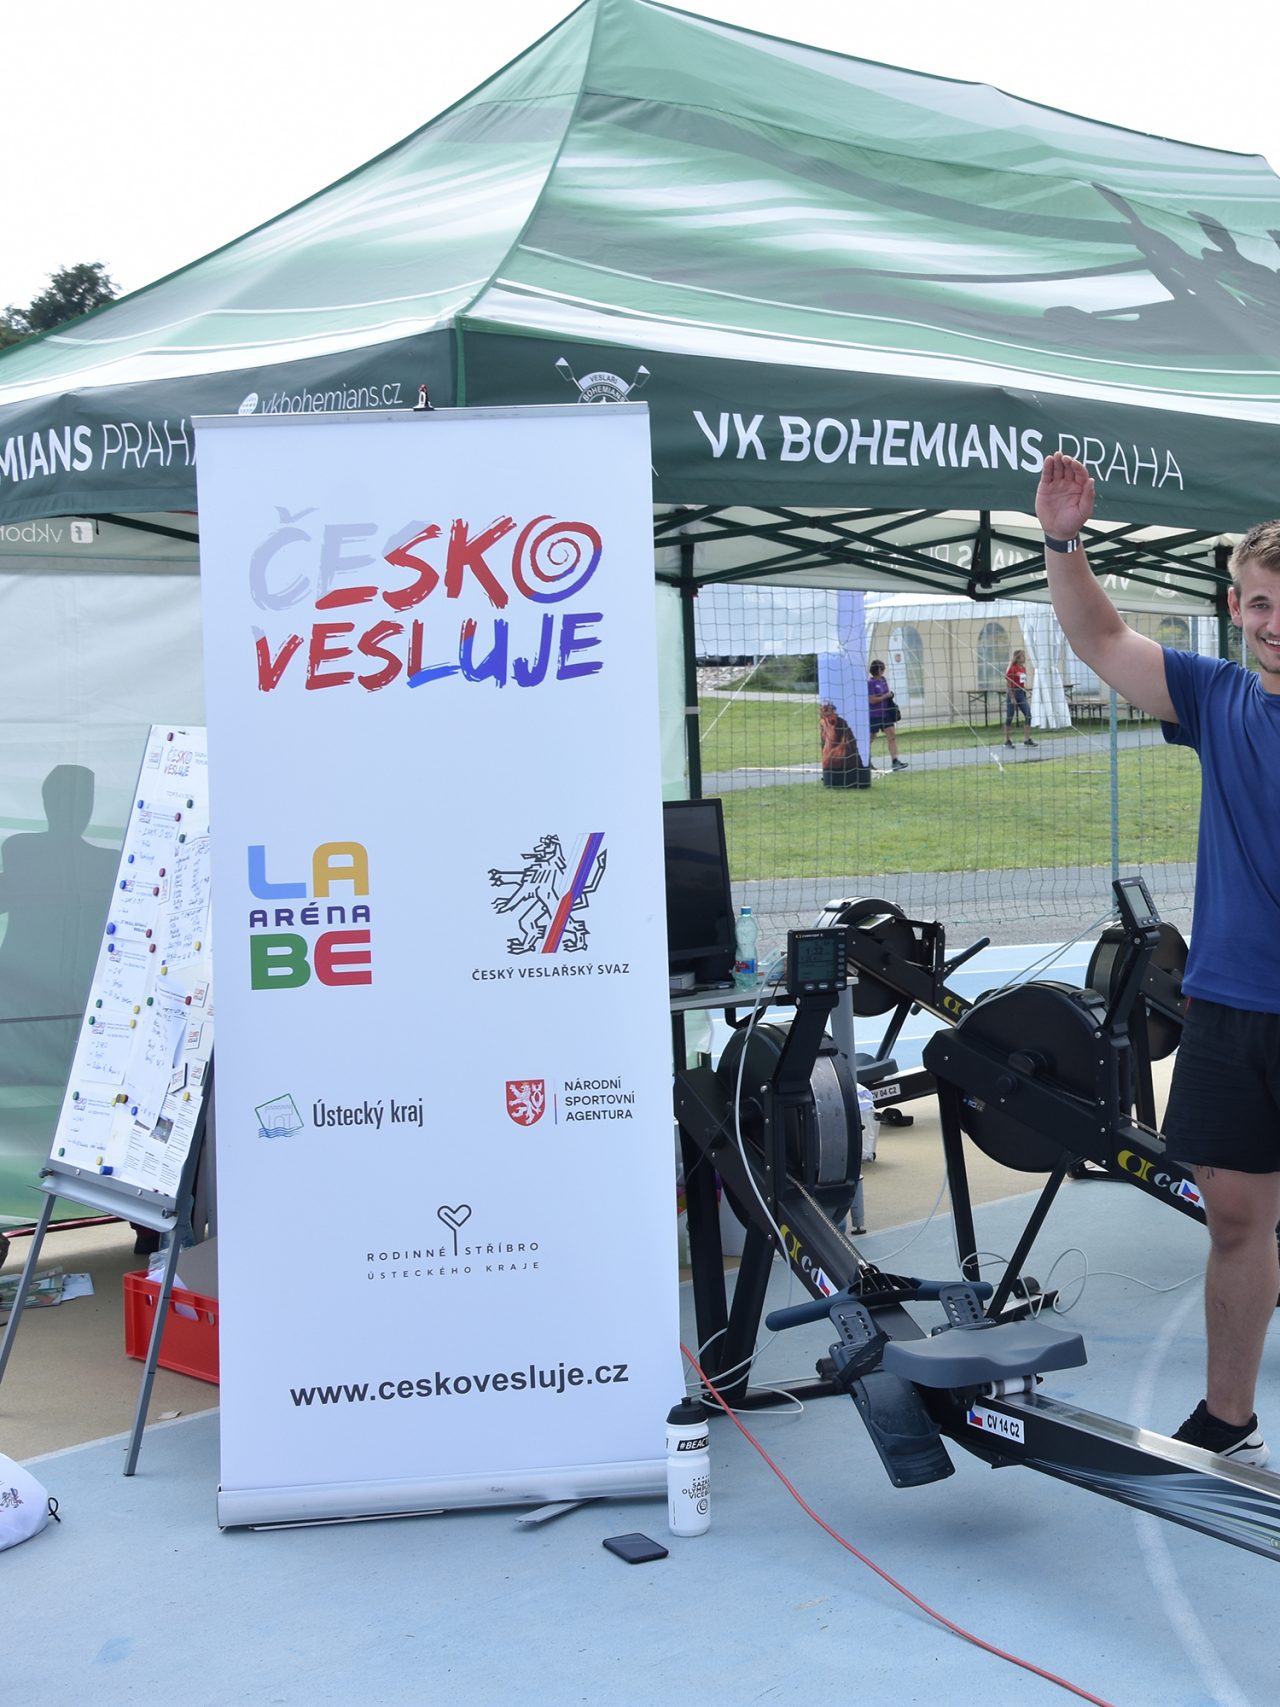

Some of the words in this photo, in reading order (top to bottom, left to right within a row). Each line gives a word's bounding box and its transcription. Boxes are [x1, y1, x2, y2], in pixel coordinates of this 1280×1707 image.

[261, 383, 404, 414] vkbohemians.cz
[101, 419, 197, 470] PRAH
[693, 410, 767, 460] VK
[779, 415, 1045, 474] BOHEMIANS
[249, 505, 603, 613] ČESKO
[249, 611, 604, 693] VESLUJE
[247, 841, 370, 900] LA
[249, 902, 371, 928] ARÉNA
[250, 929, 373, 990] BE
[472, 967, 514, 981] ČESKÝ
[518, 963, 593, 979] VESLAŘSKÝ
[597, 963, 630, 975] SVAZ
[564, 1075, 622, 1091] NÁRODNÍ
[565, 1090, 635, 1107] SPORTOVNÍ
[313, 1098, 384, 1130] Ústecký
[391, 1098, 423, 1128] kraj
[565, 1109, 633, 1122] AGENTURA
[367, 1246, 446, 1262] RODINNÉ
[465, 1242, 539, 1256] STŘÍBRO
[367, 1266, 471, 1280] ÚSTECKÉHO
[486, 1262, 539, 1273] KRAJE
[290, 1362, 629, 1407] www.ceskovesluje.cz
[987, 1414, 998, 1430] CV
[999, 1418, 1009, 1434] 14
[1009, 1421, 1020, 1438] C2
